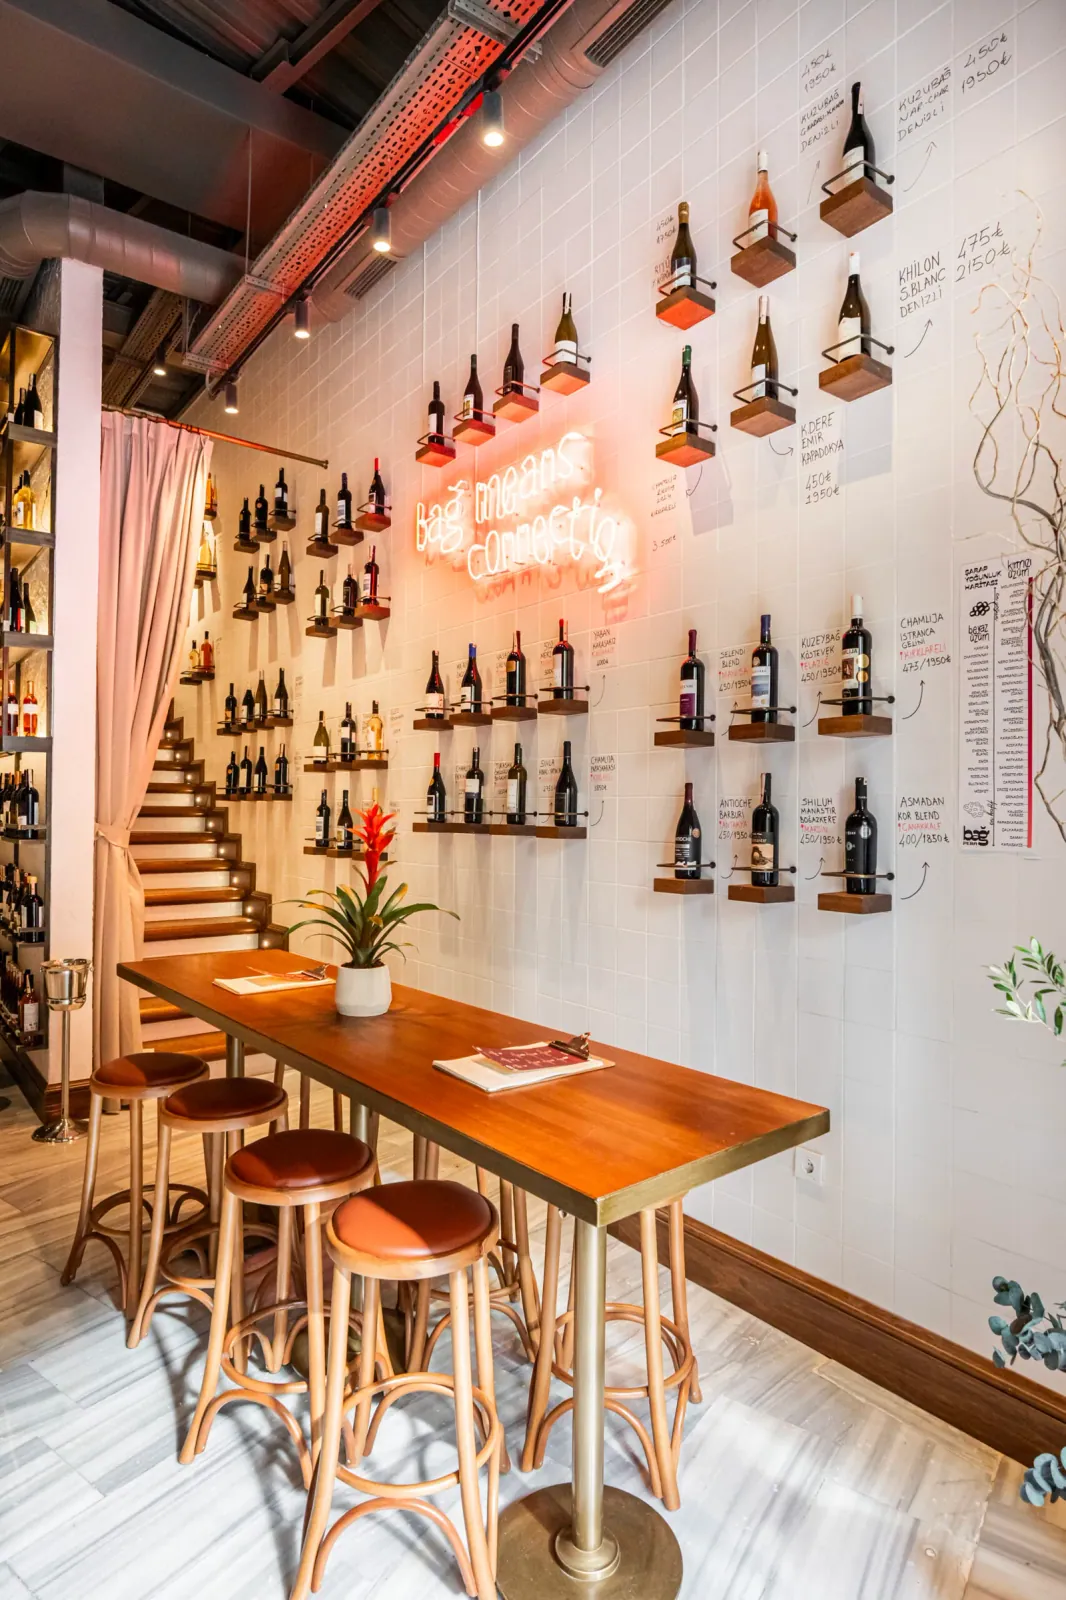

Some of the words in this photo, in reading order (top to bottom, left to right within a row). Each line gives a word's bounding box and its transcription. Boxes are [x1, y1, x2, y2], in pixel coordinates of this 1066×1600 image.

[475, 431, 590, 523] means
[900, 796, 945, 808] ASMADAN
[897, 811, 912, 821] KOR
[915, 810, 940, 821] BLEND
